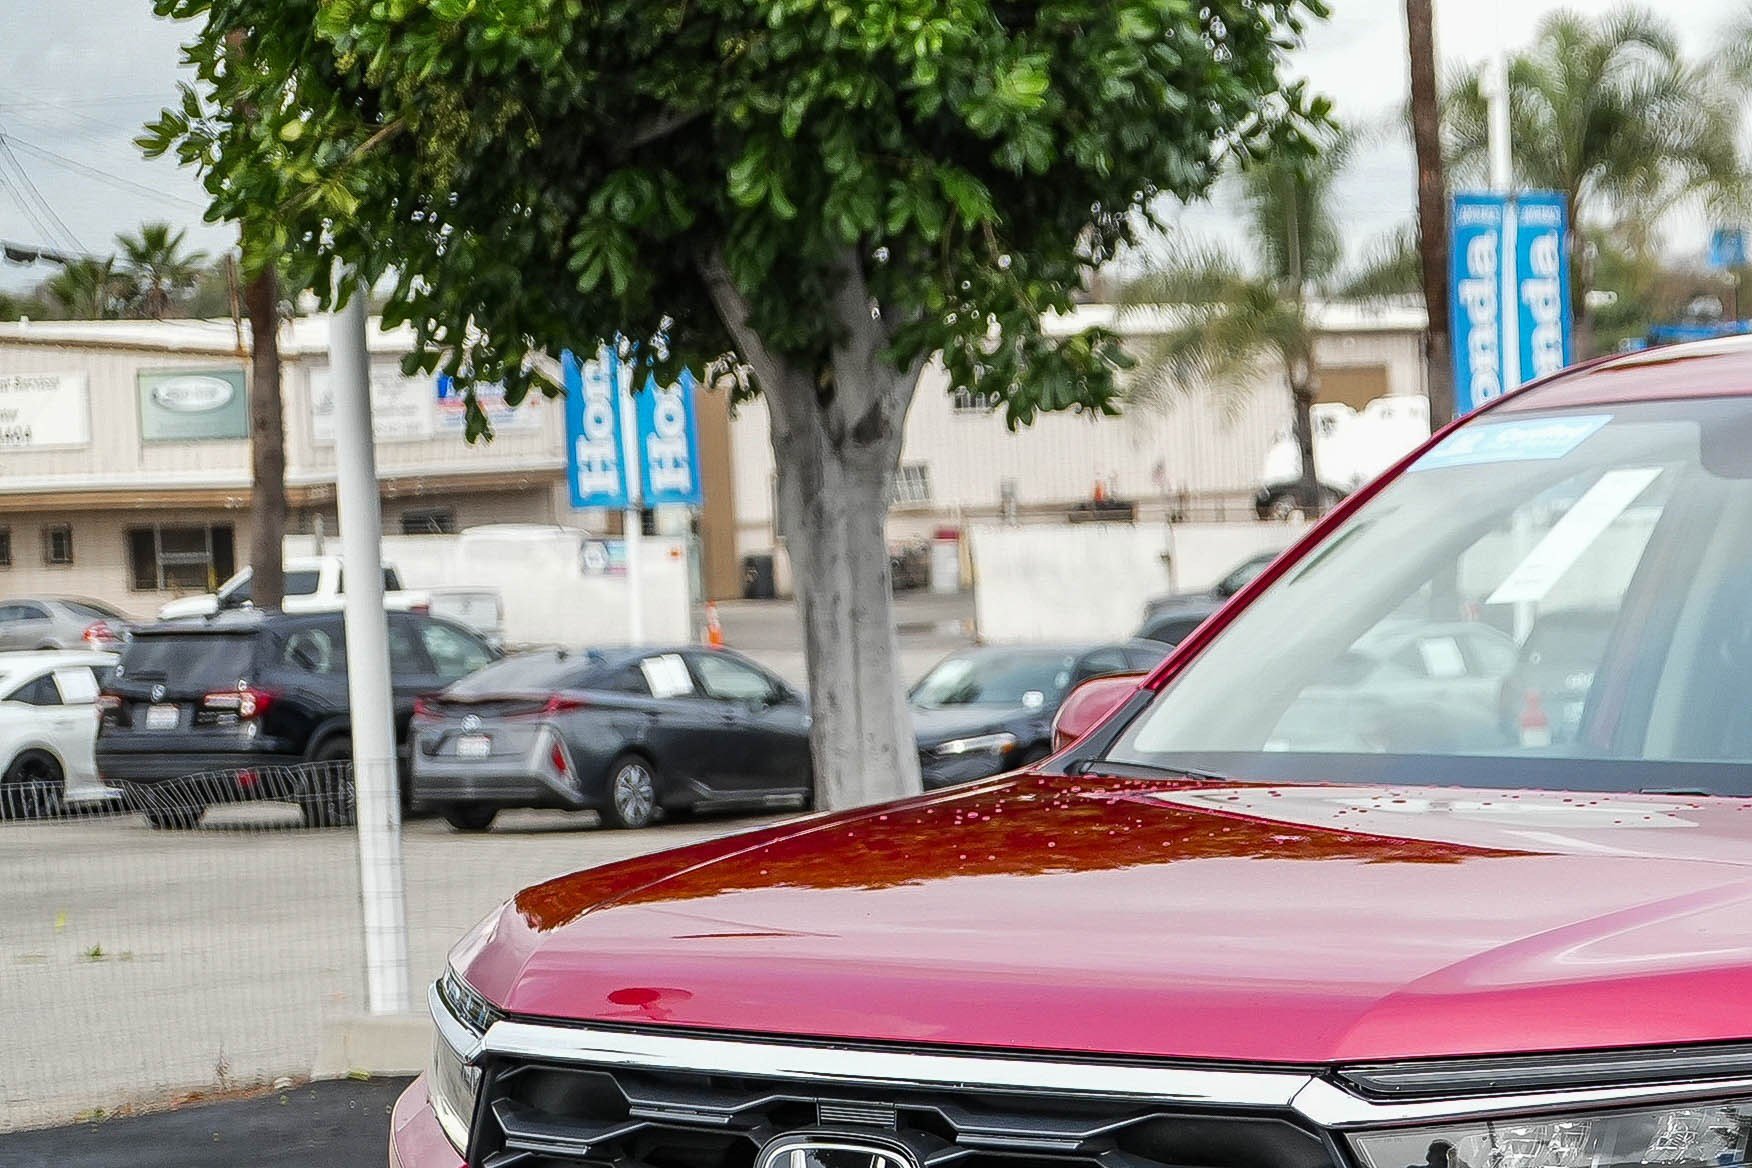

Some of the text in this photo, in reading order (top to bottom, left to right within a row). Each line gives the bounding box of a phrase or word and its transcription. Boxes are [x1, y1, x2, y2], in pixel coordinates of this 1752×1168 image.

[1458, 230, 1500, 407] onda
[1520, 230, 1563, 378] nda
[575, 354, 619, 498] Hon
